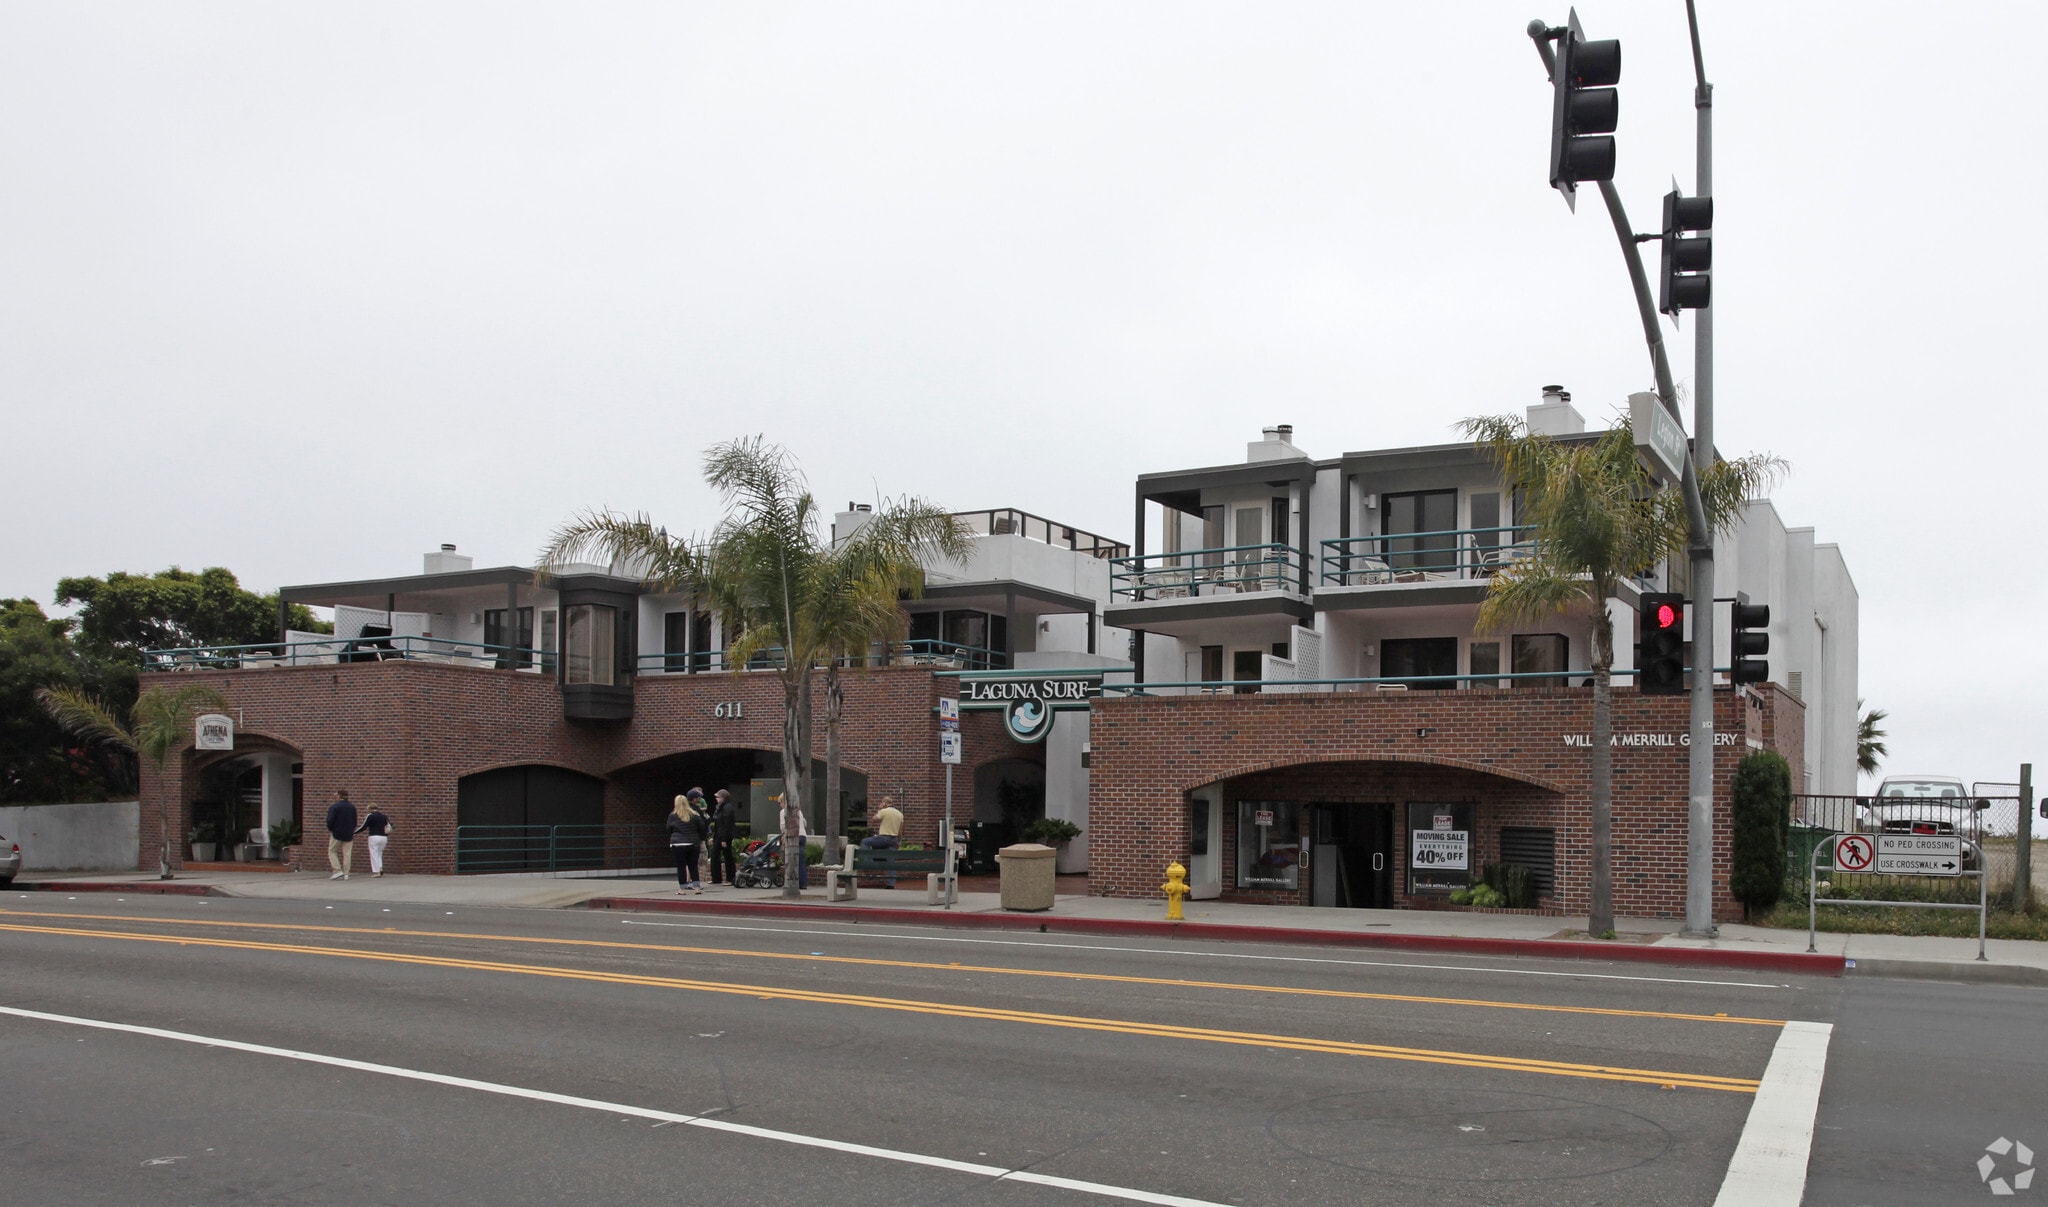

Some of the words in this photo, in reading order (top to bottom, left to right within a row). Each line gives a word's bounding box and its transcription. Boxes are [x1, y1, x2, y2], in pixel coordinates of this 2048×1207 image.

[970, 682, 1038, 699] LAGUNA
[1042, 680, 1089, 699] SURF
[715, 702, 743, 717] 611
[203, 725, 228, 736] ATHENA
[1563, 734, 1618, 747] WILLM
[1622, 734, 1675, 746] MERRILL
[1680, 733, 1738, 746] GERY
[1416, 832, 1445, 840] MOVING
[1446, 833, 1465, 841] SALE
[1883, 840, 1894, 848] NO
[1915, 841, 1955, 849] CROSSING
[1416, 850, 1446, 864] 40%
[1446, 852, 1464, 860] OFF
[1880, 860, 1894, 868] USE
[1896, 861, 1939, 869] CROSSWALK
